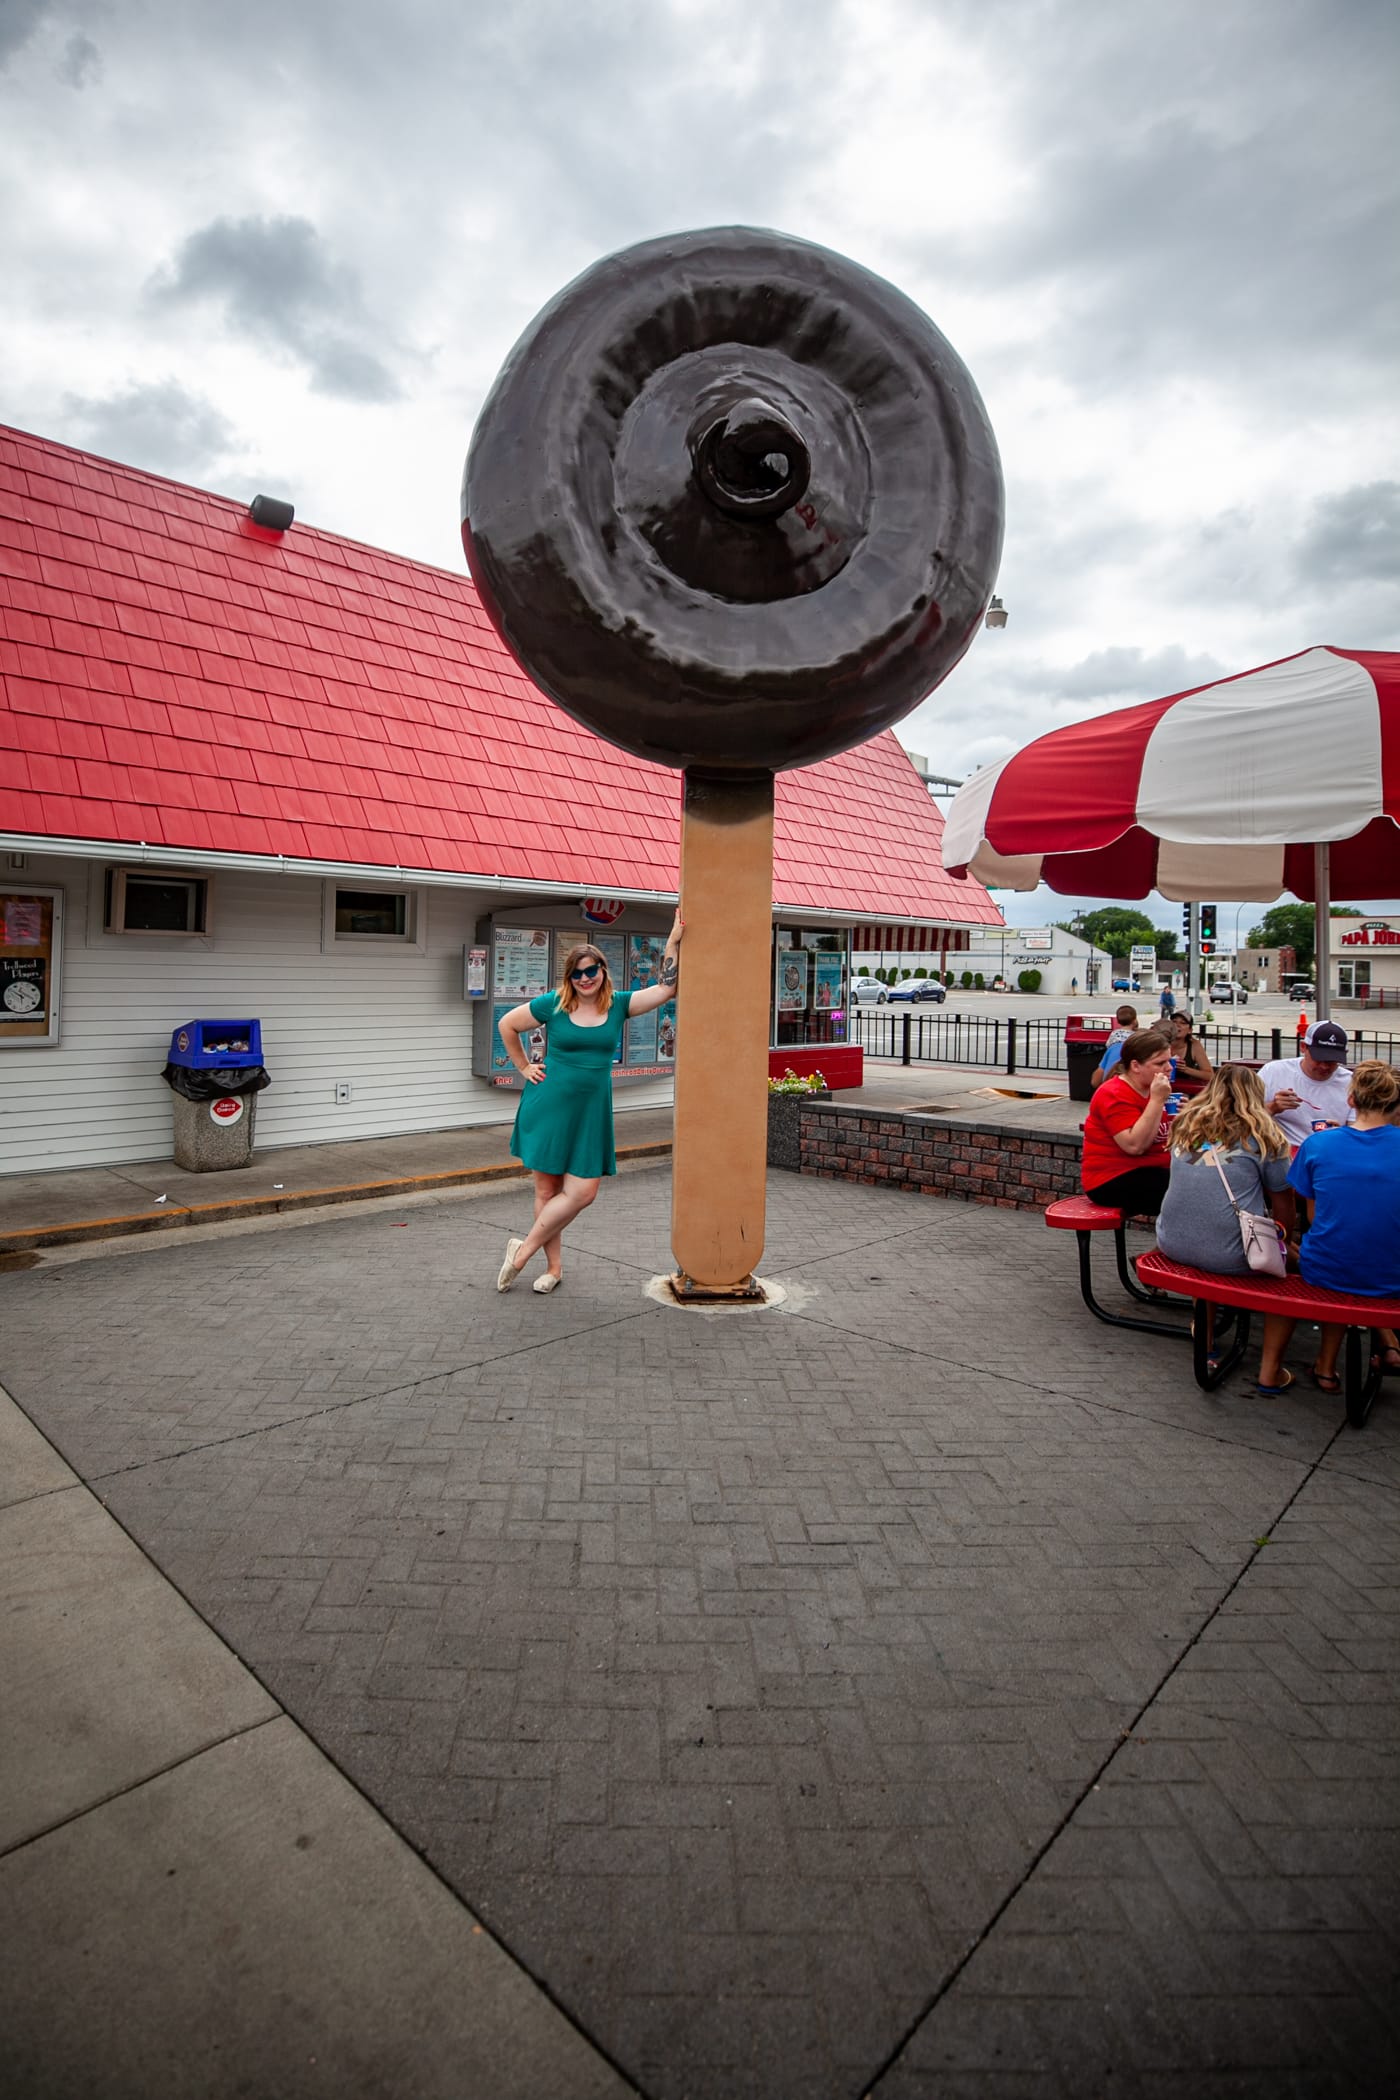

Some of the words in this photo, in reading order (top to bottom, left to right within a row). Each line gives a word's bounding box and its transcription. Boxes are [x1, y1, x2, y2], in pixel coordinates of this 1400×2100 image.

[592, 898, 619, 917] DQ
[495, 931, 522, 942] Blizzard
[1341, 930, 1370, 945] PAPA
